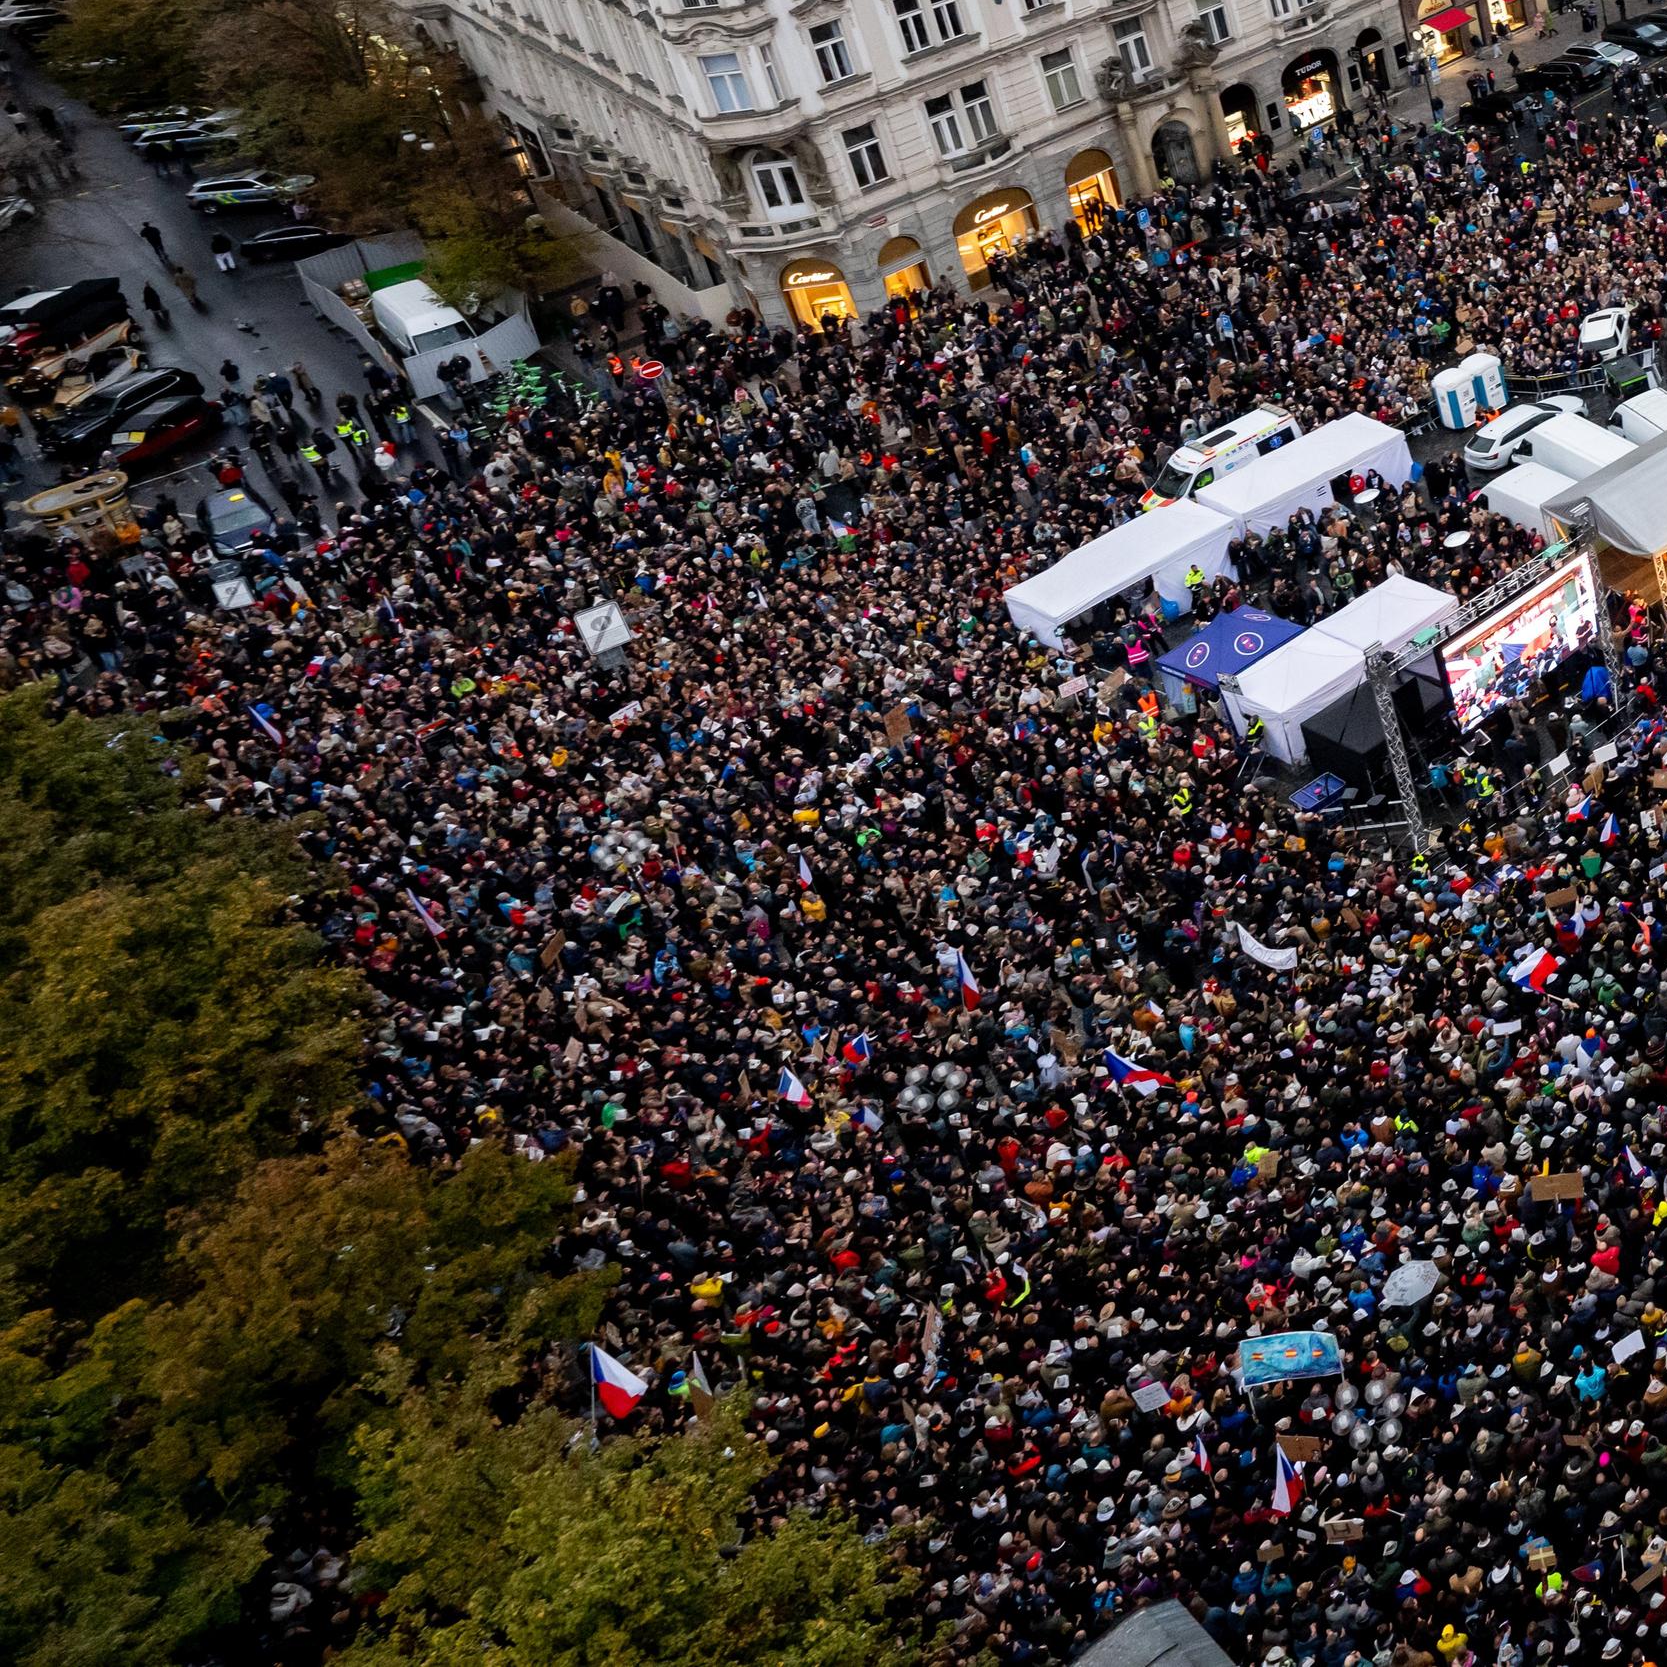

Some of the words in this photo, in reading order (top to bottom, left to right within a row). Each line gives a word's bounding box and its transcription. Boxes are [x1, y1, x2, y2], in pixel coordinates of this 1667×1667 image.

[1424, 1, 1446, 14] OMEGA
[1295, 60, 1322, 76] TUDOR
[975, 204, 1009, 223] Cartier
[788, 272, 834, 285] Cartier
[1225, 428, 1278, 457] AMBULANCE
